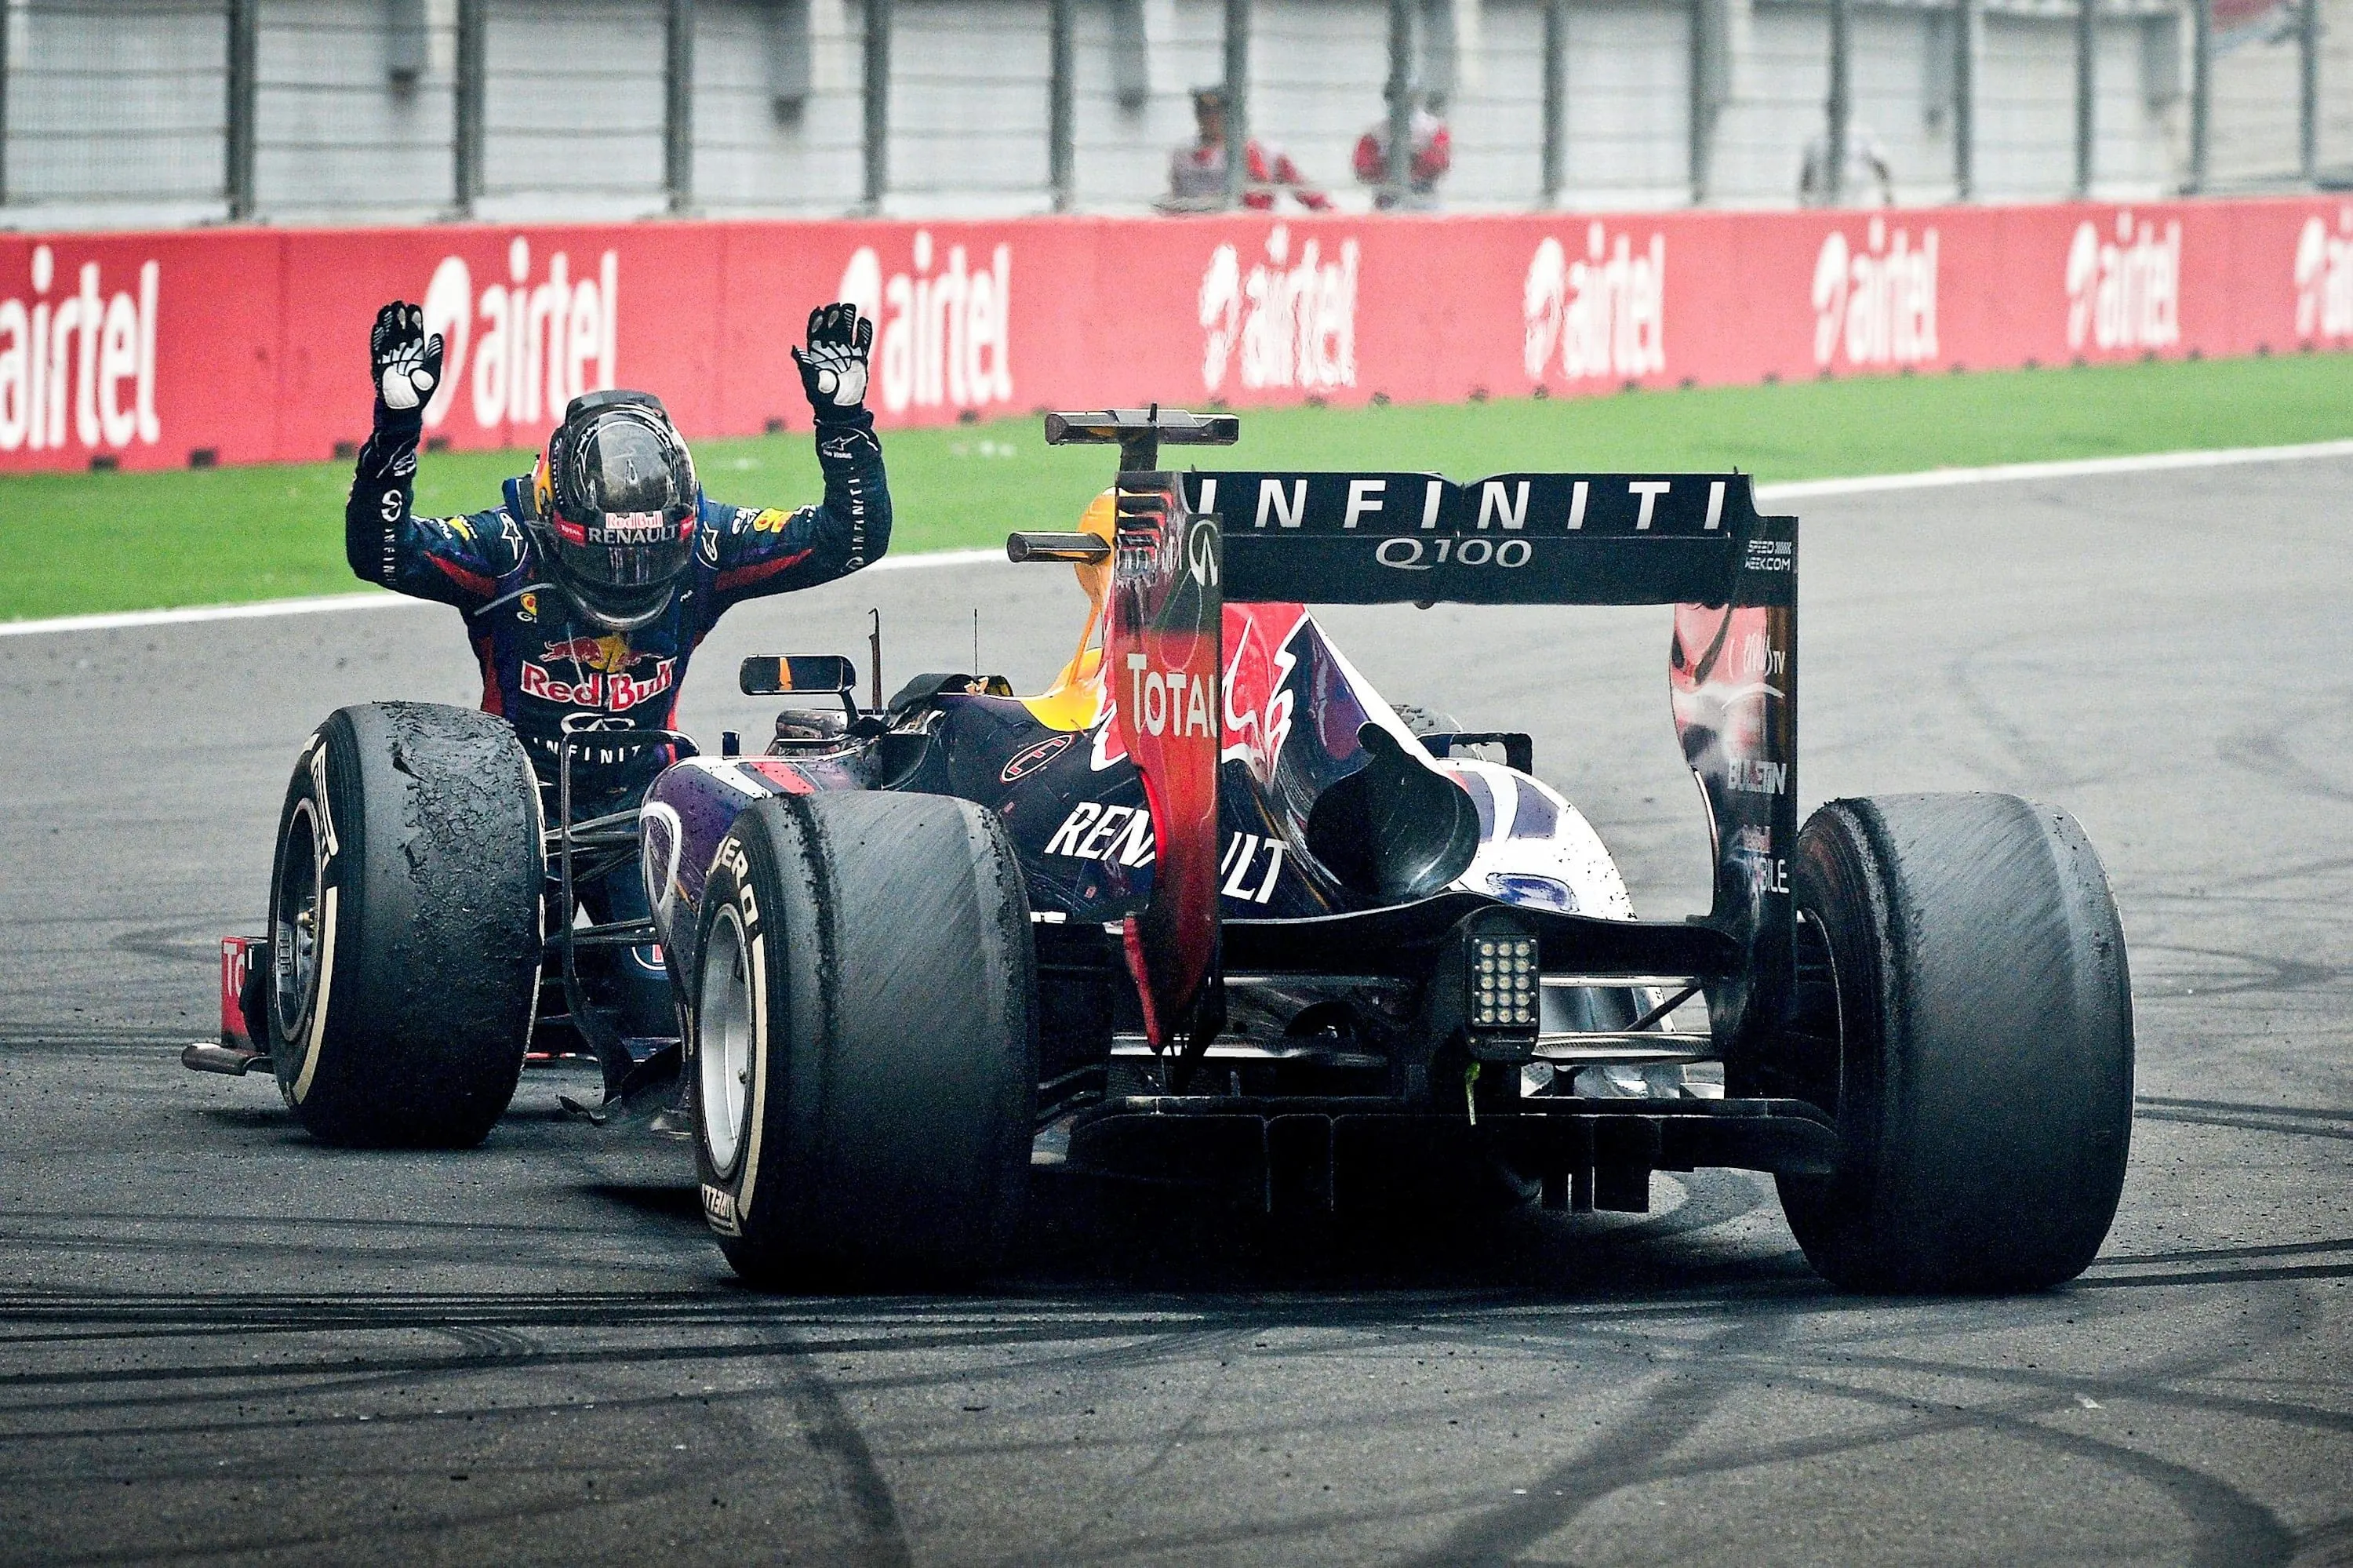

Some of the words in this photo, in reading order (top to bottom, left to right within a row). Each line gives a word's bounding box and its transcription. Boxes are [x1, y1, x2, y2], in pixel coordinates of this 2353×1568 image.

[474, 236, 618, 428] airtel
[883, 230, 1012, 412] airtel
[0, 246, 159, 451] airtel
[606, 512, 635, 529] Red
[636, 511, 664, 528] Bull
[1198, 478, 1724, 530] INFINITI
[589, 524, 678, 544] RENAULT
[1376, 538, 1533, 570] Q100
[521, 660, 602, 706] Red
[609, 657, 678, 711] Bull
[1127, 653, 1217, 737] TOTAL
[533, 737, 641, 764] NFINIT
